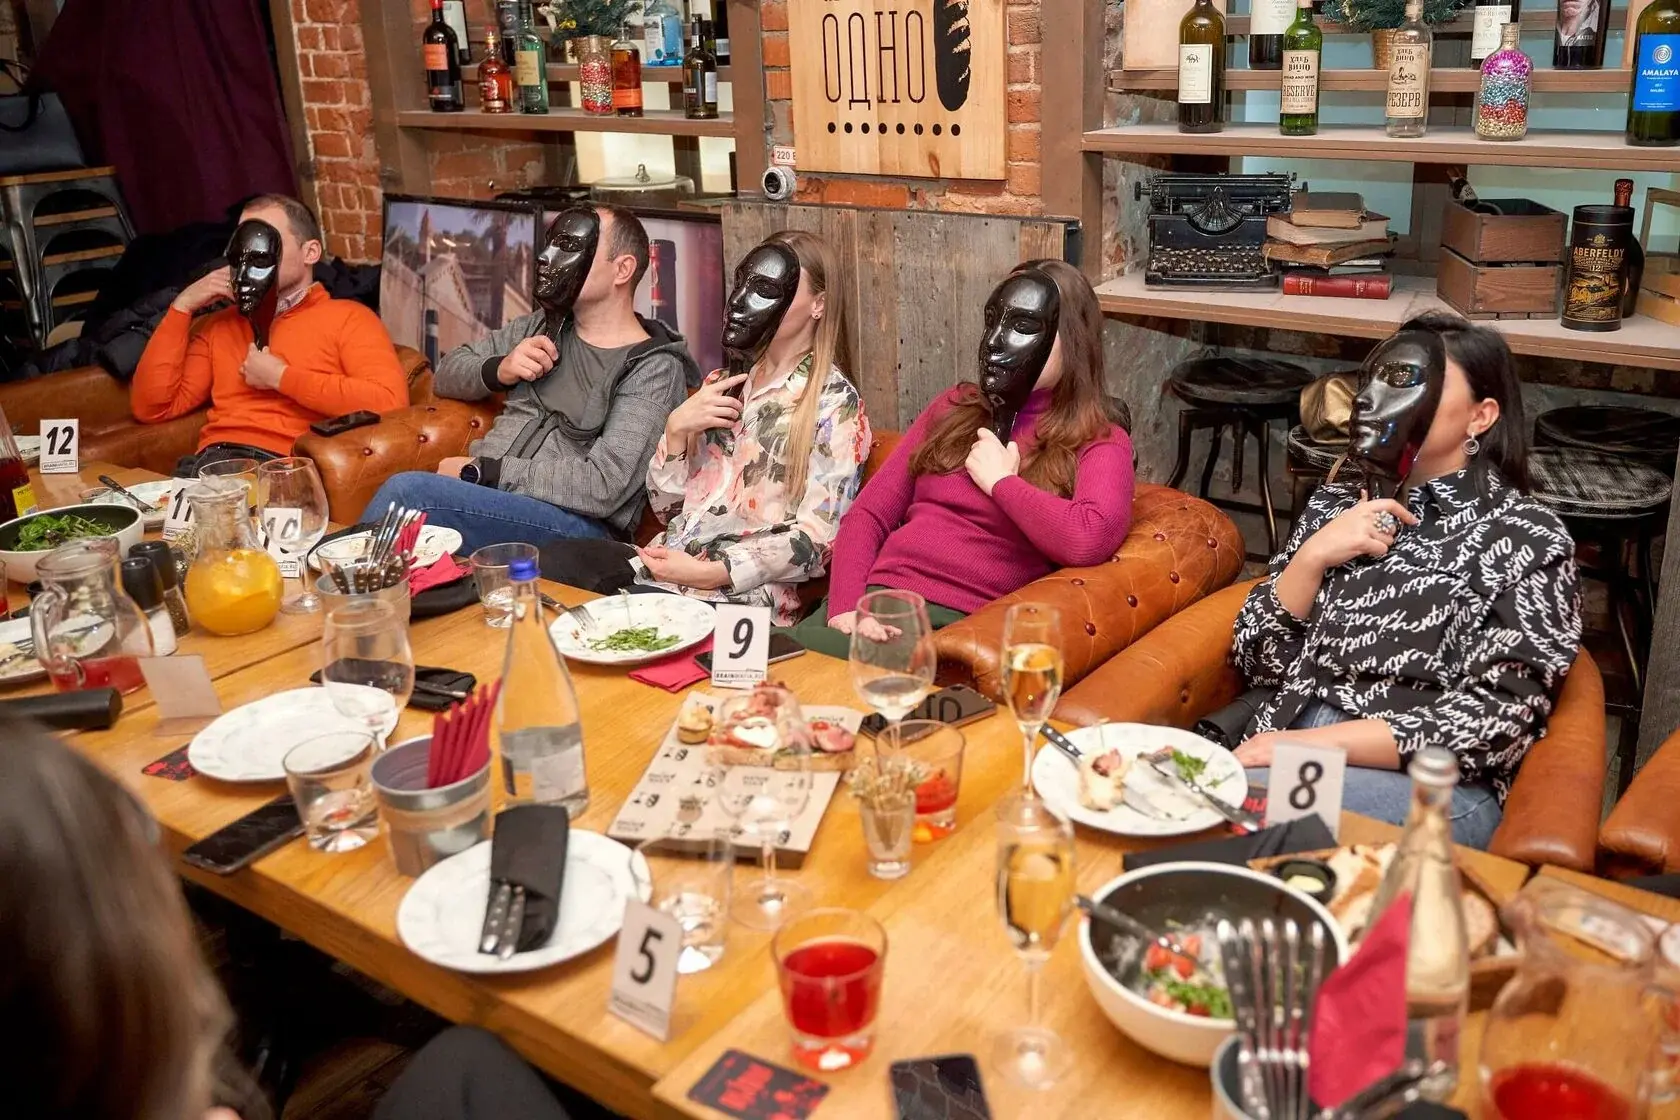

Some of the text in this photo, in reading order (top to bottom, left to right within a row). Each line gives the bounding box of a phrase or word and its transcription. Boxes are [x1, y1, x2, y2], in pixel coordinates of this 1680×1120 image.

[822, 10, 926, 110] ОДНО
[776, 150, 791, 160] 220
[1573, 246, 1625, 258] ABERFELDY
[46, 426, 75, 456] 12
[728, 617, 754, 659] 9
[1288, 761, 1324, 810] 8
[630, 924, 664, 984] 5
